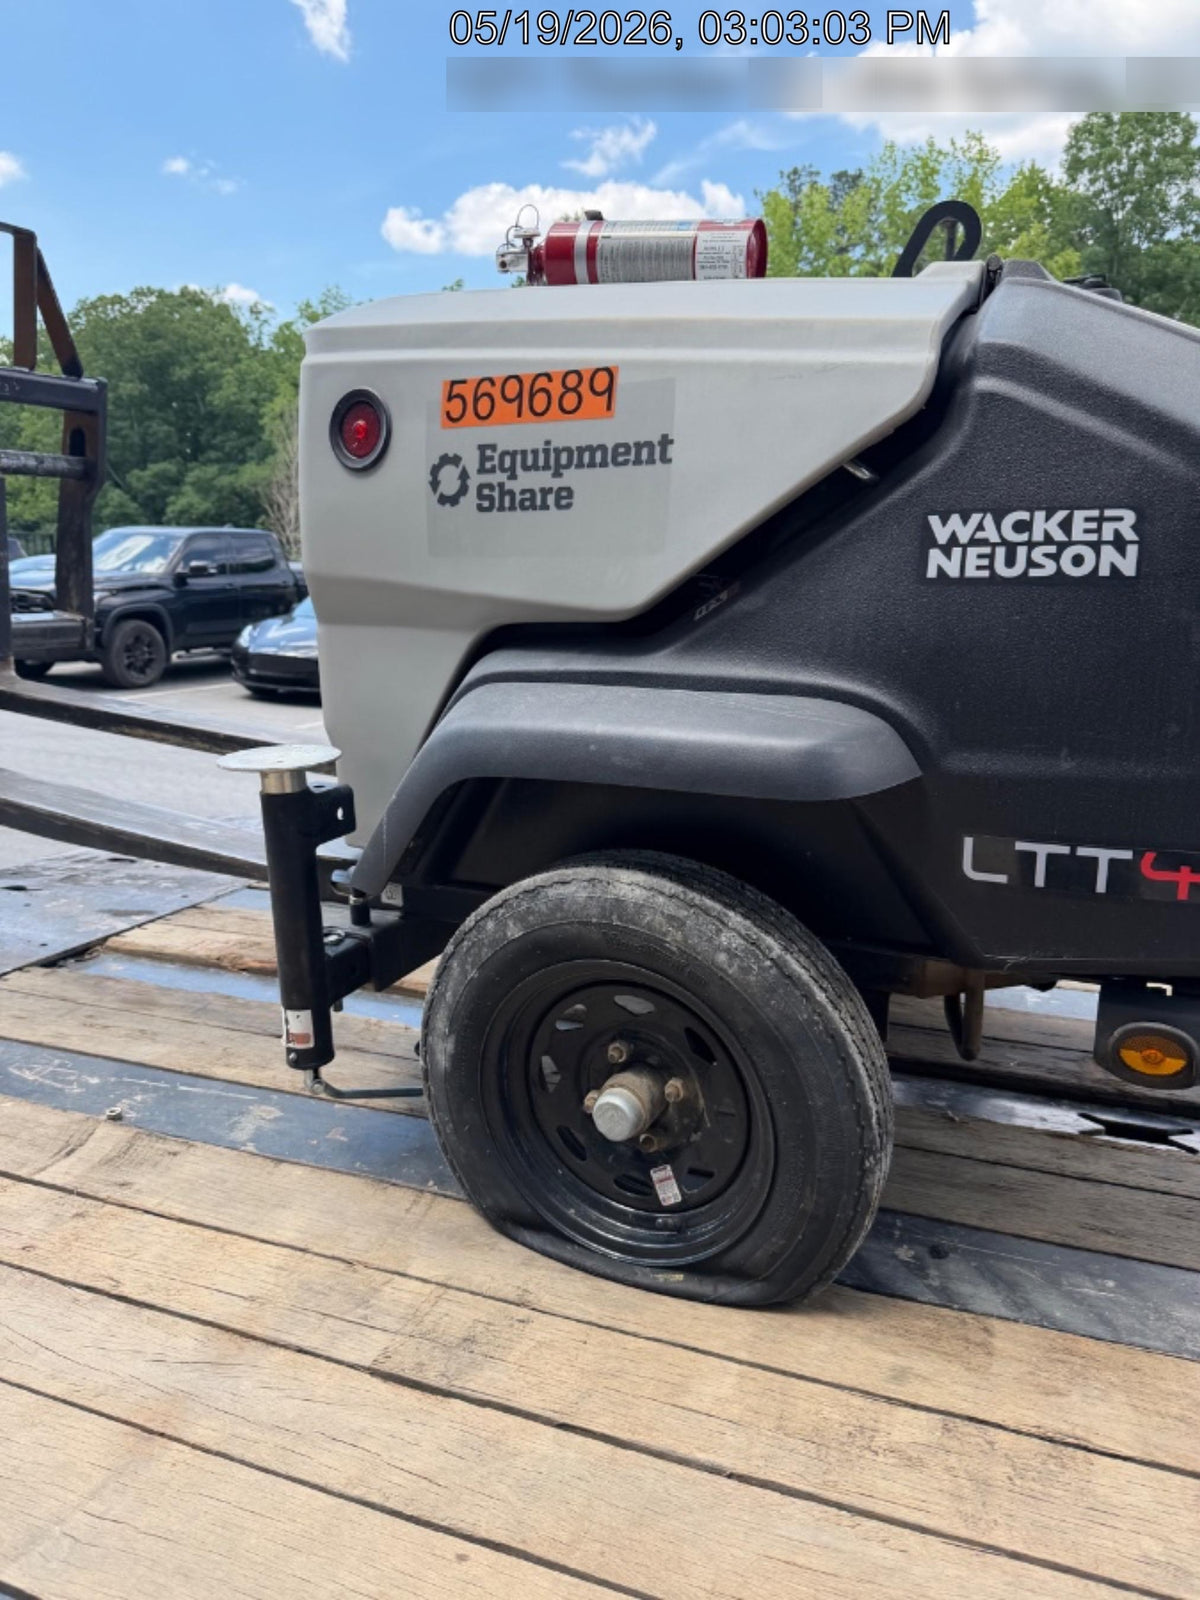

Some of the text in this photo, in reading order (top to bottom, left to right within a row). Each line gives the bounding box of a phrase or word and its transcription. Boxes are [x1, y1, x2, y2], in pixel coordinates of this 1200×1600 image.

[445, 366, 615, 423] 569689
[476, 433, 674, 480] Equipment
[476, 482, 574, 512] Share
[927, 508, 1140, 544] WACKER
[926, 543, 1139, 578] NEUSON
